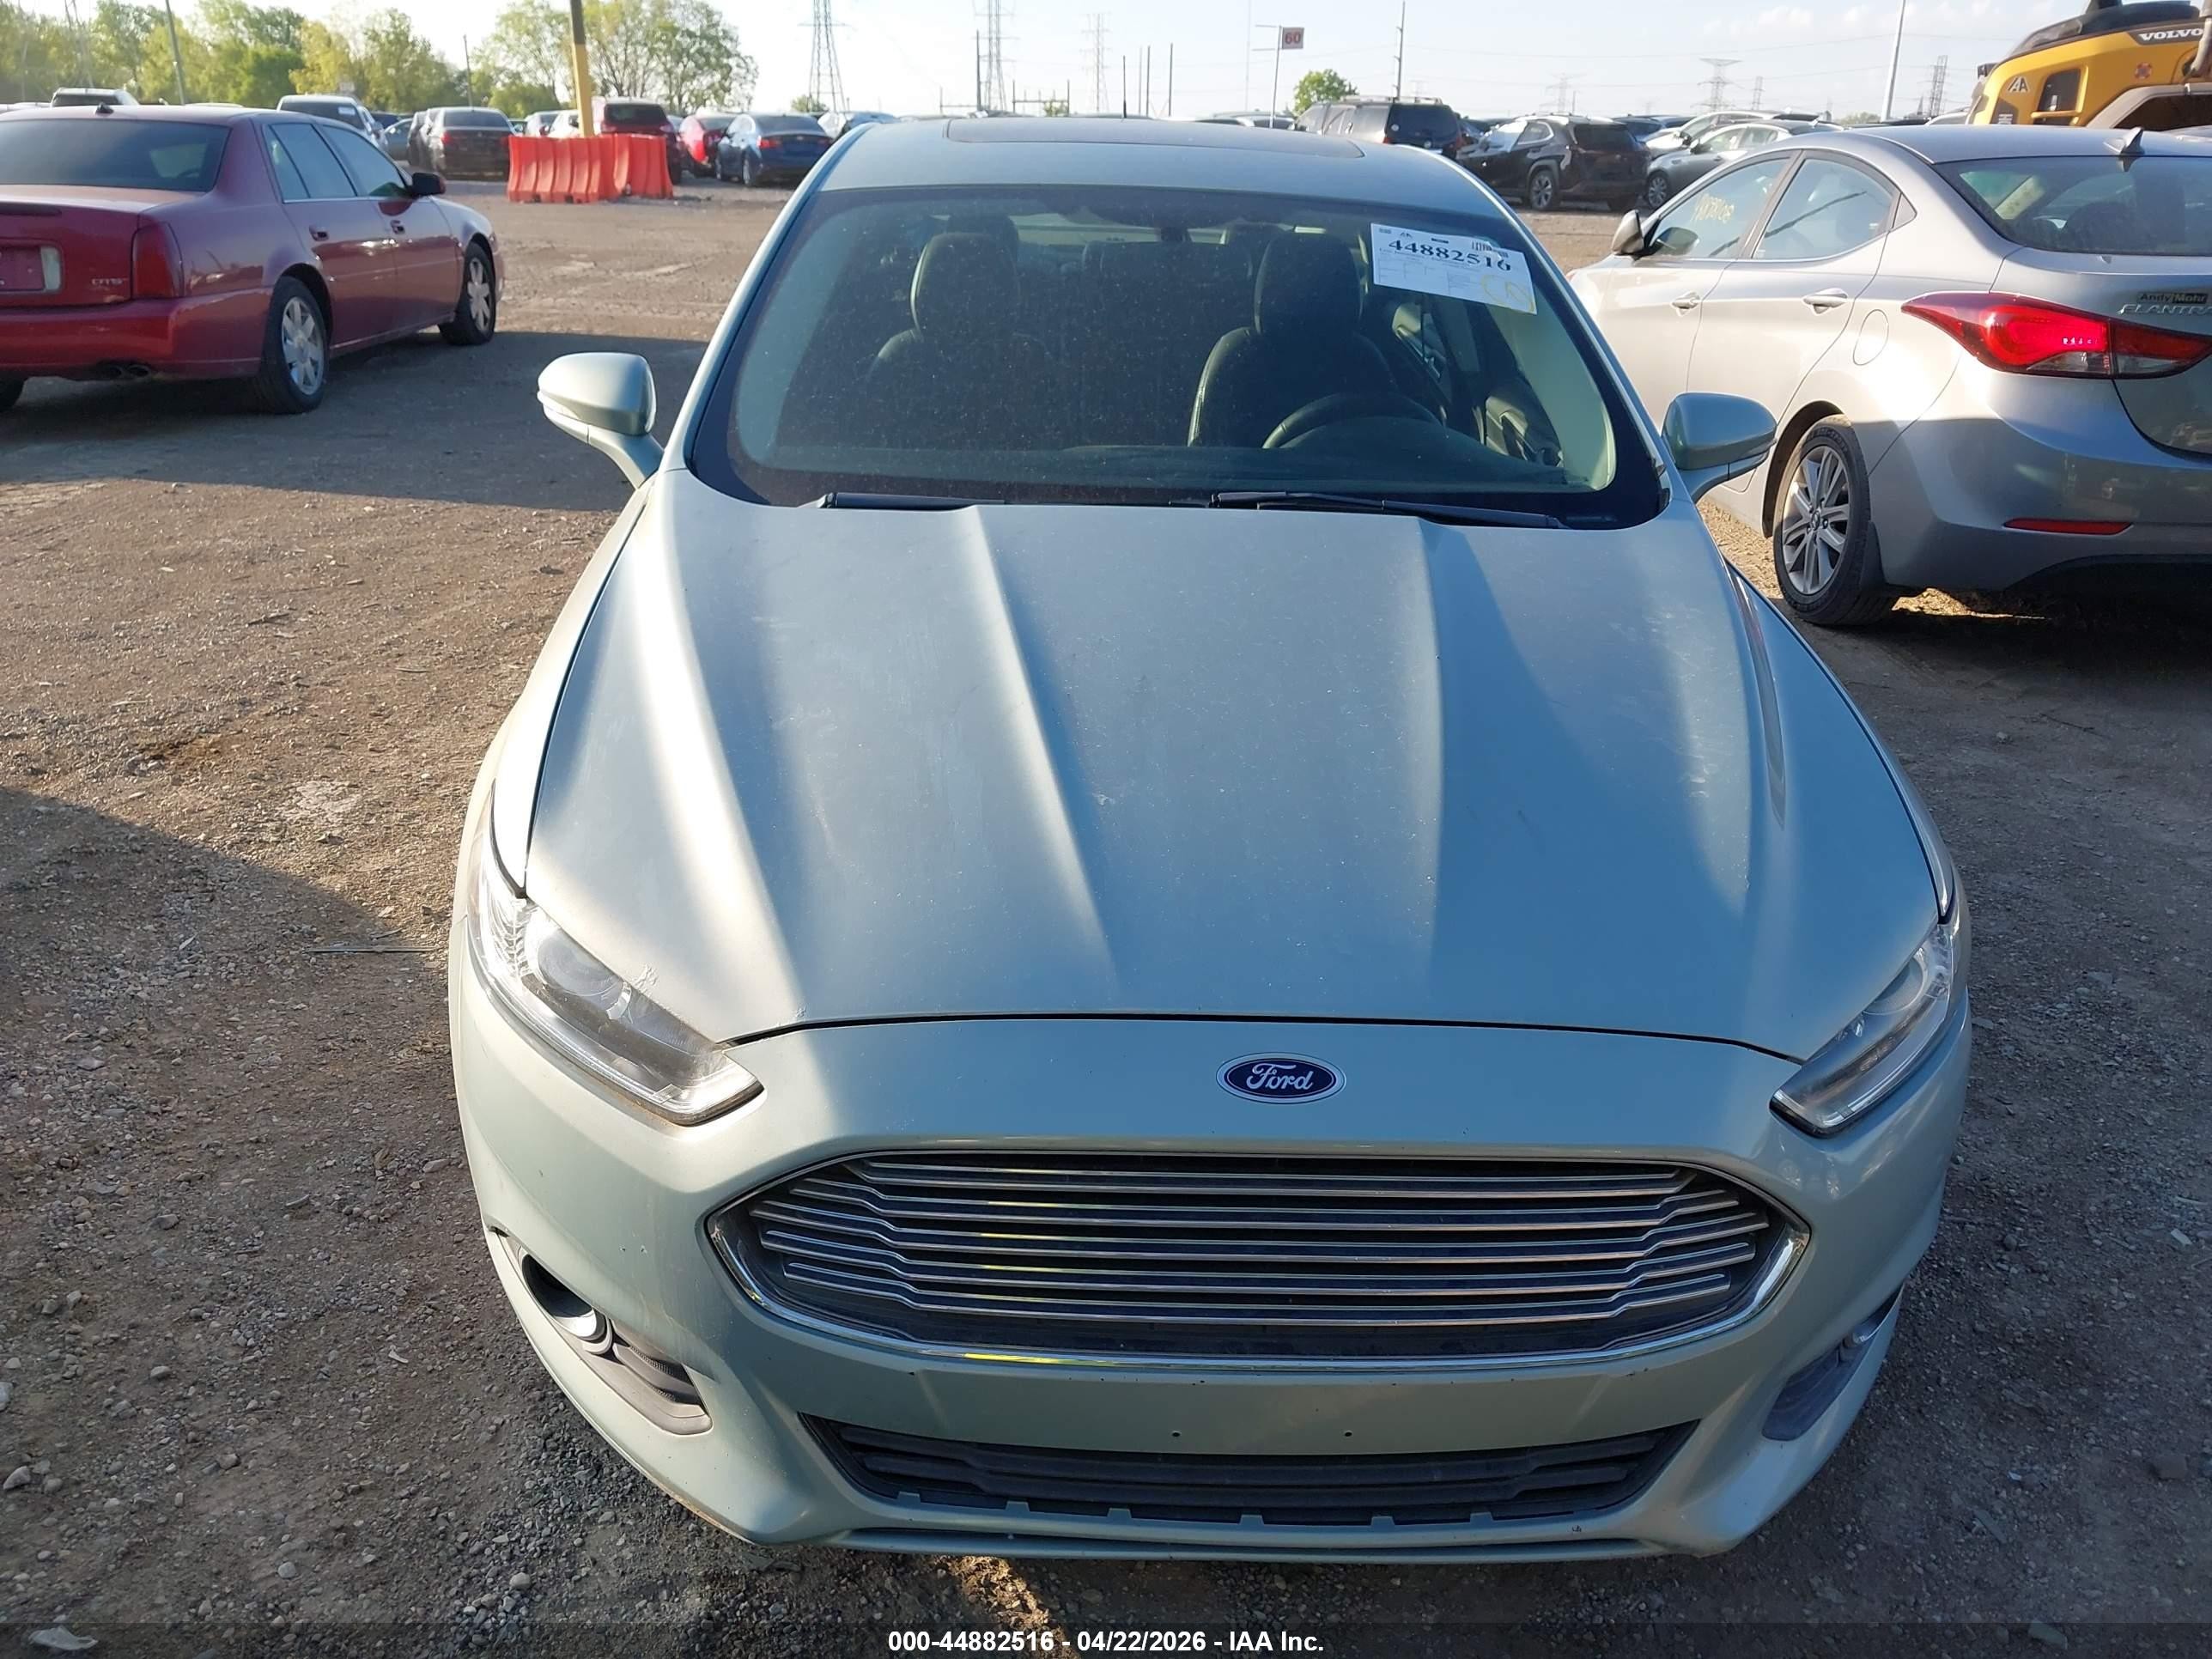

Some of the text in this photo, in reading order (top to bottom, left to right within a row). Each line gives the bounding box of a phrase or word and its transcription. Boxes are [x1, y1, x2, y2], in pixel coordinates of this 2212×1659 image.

[1285, 33, 1301, 45] 60
[2138, 28, 2204, 41] VOLVO
[1389, 239, 1511, 271] 44882516
[1246, 1062, 1314, 1090] Ford
